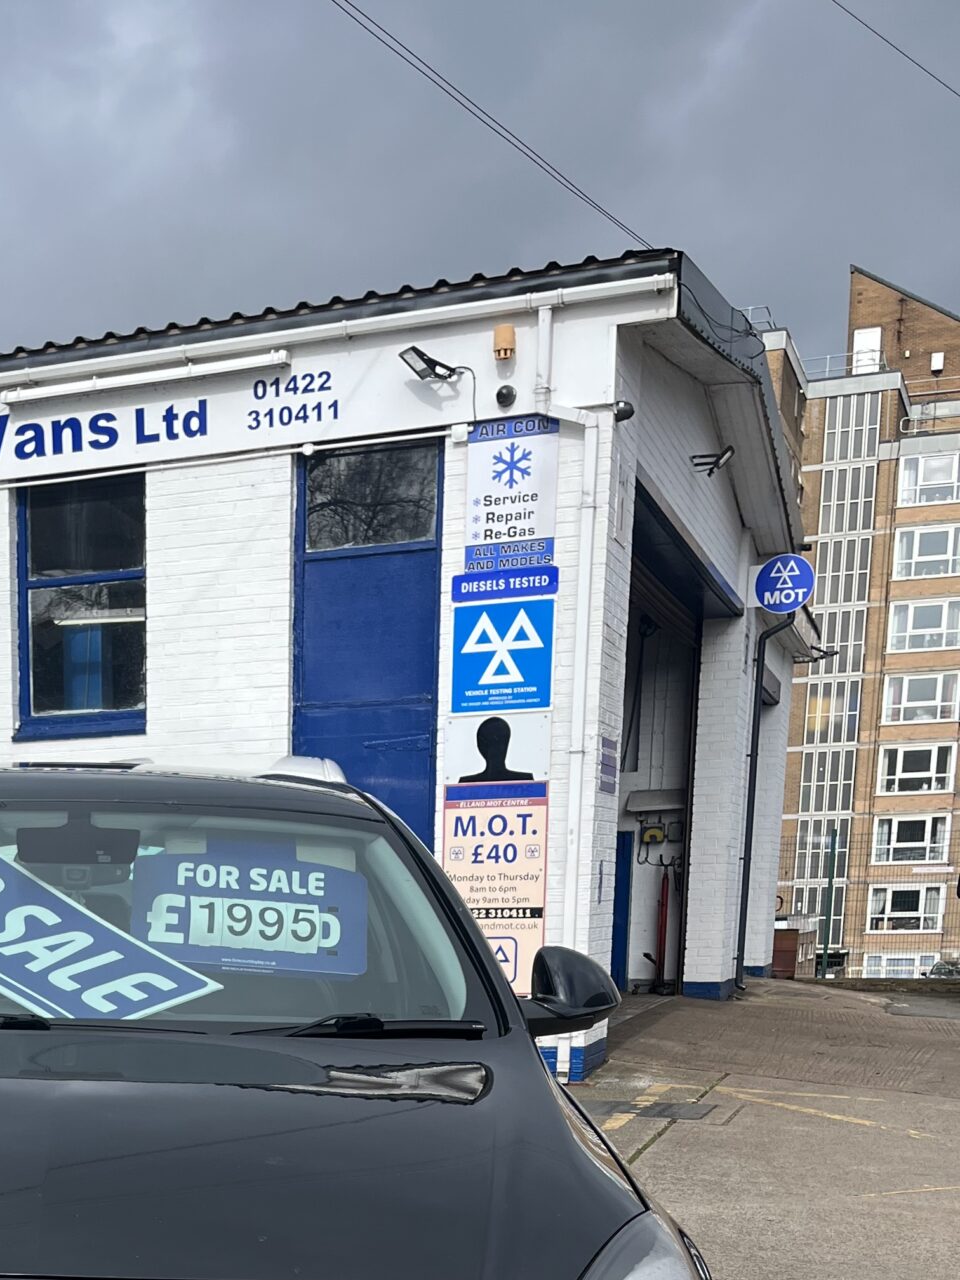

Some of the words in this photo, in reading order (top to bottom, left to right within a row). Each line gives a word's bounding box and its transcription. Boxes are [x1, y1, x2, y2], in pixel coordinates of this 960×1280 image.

[252, 370, 332, 401] 01422
[135, 399, 208, 445] Ltd
[247, 399, 339, 431] 310411
[479, 422, 506, 438] AIR
[513, 417, 550, 434] CON
[483, 491, 539, 507] Service
[485, 509, 535, 525] Repair
[484, 526, 535, 541] Re-Gas
[474, 545, 496, 558] ALL
[500, 541, 545, 555] MAKES
[467, 559, 494, 572] AND
[498, 554, 551, 570] MODELS
[461, 577, 506, 593] DIESELS
[509, 575, 549, 590] TESTED
[763, 588, 807, 605] MOT
[460, 800, 486, 808] ELLAND
[453, 813, 538, 837] M.O.T.
[471, 843, 518, 864] £40
[176, 862, 240, 890] FOR
[248, 867, 325, 897] SALE
[448, 873, 485, 883] Monday
[486, 874, 496, 882] to
[497, 872, 540, 883] Thursday
[469, 885, 487, 893] 8am
[498, 885, 517, 894] 6pm
[482, 896, 500, 904] 9am
[511, 896, 529, 904] 5pm
[488, 908, 532, 918] 310411
